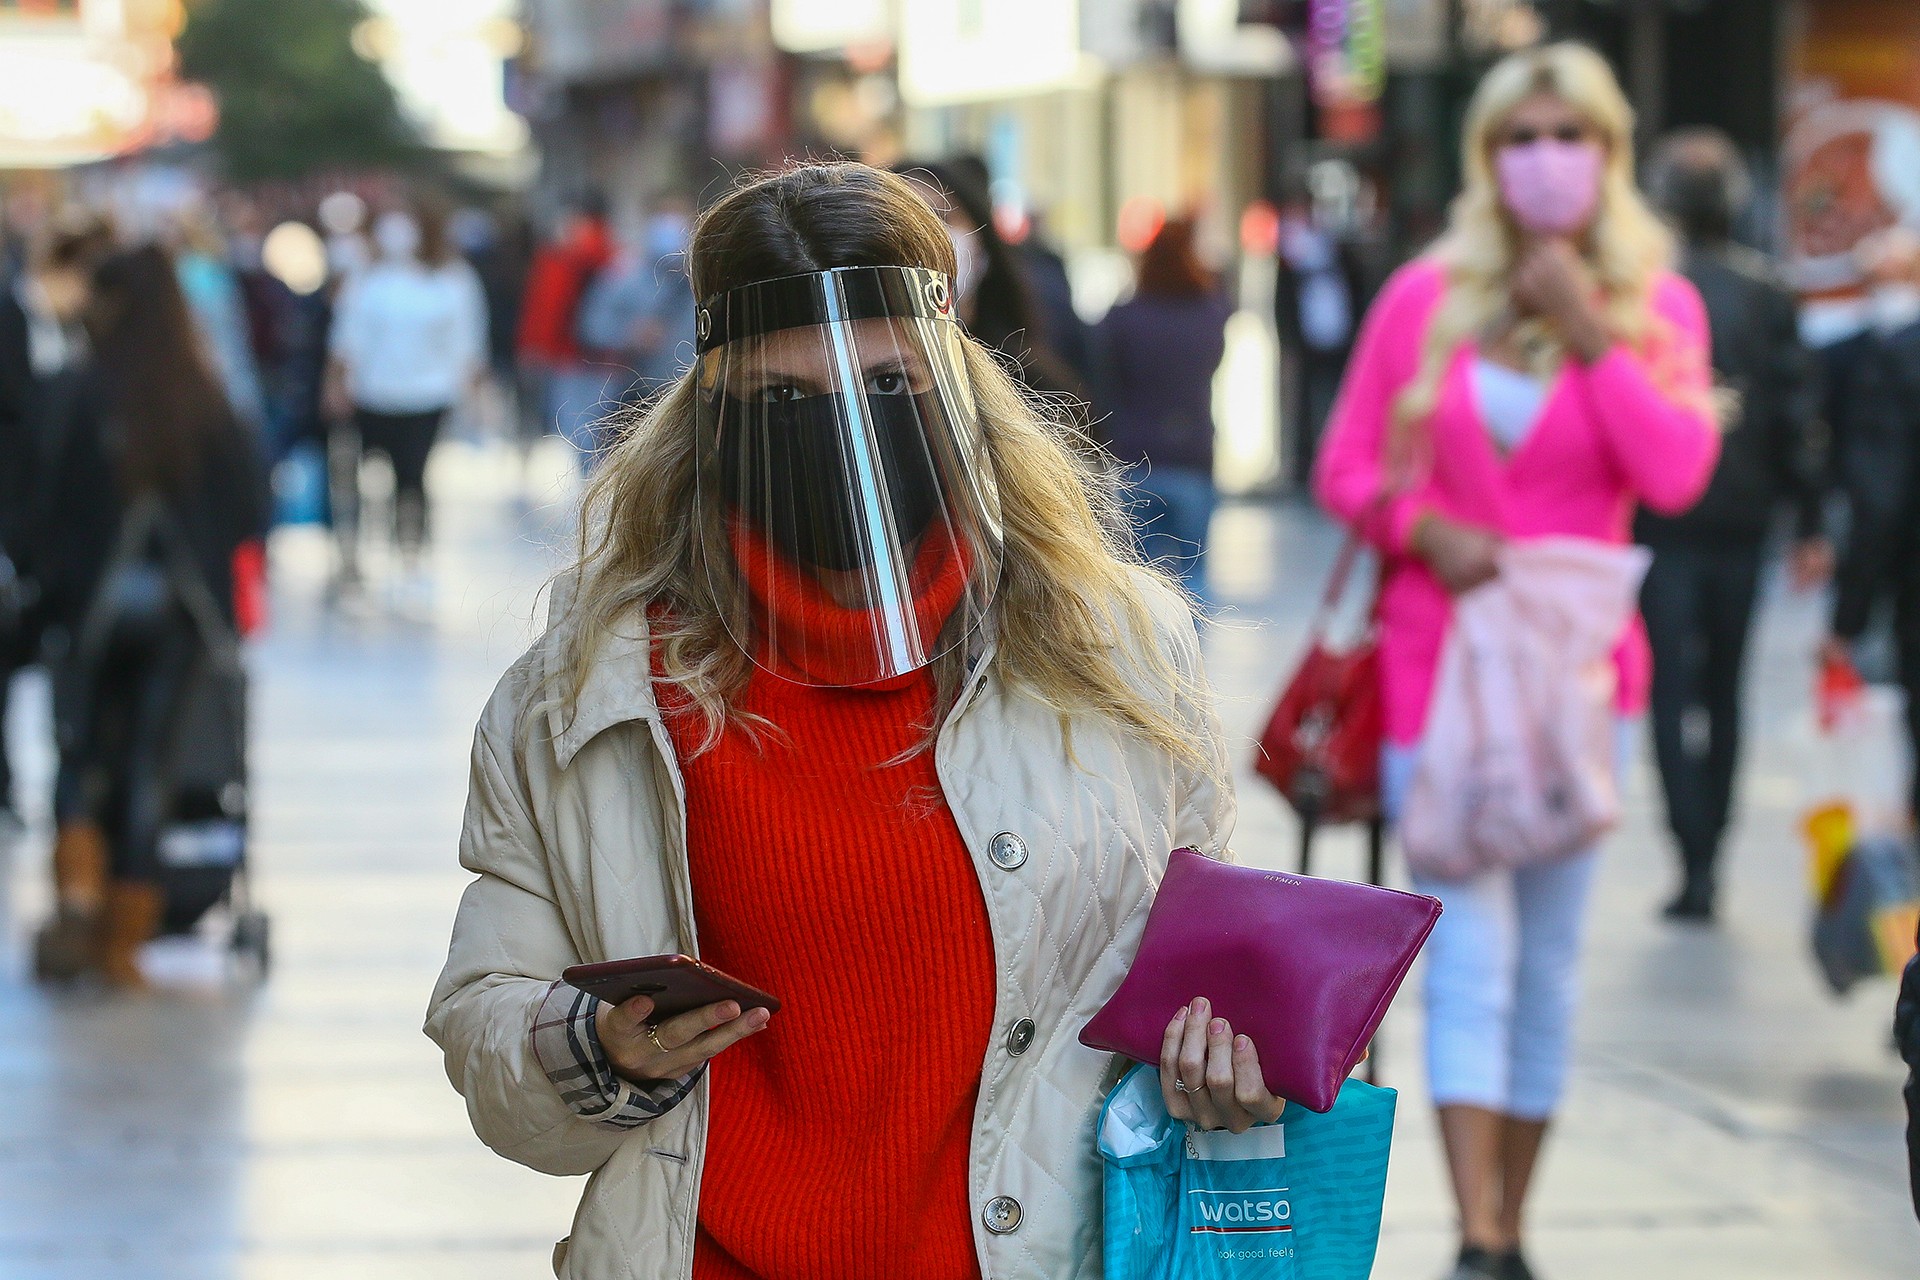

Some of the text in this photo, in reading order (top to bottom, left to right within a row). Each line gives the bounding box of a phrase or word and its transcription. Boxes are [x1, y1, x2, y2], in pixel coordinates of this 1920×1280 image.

[1199, 1199, 1291, 1222] watso
[1238, 1248, 1267, 1260] good.
[1268, 1246, 1288, 1258] feel
